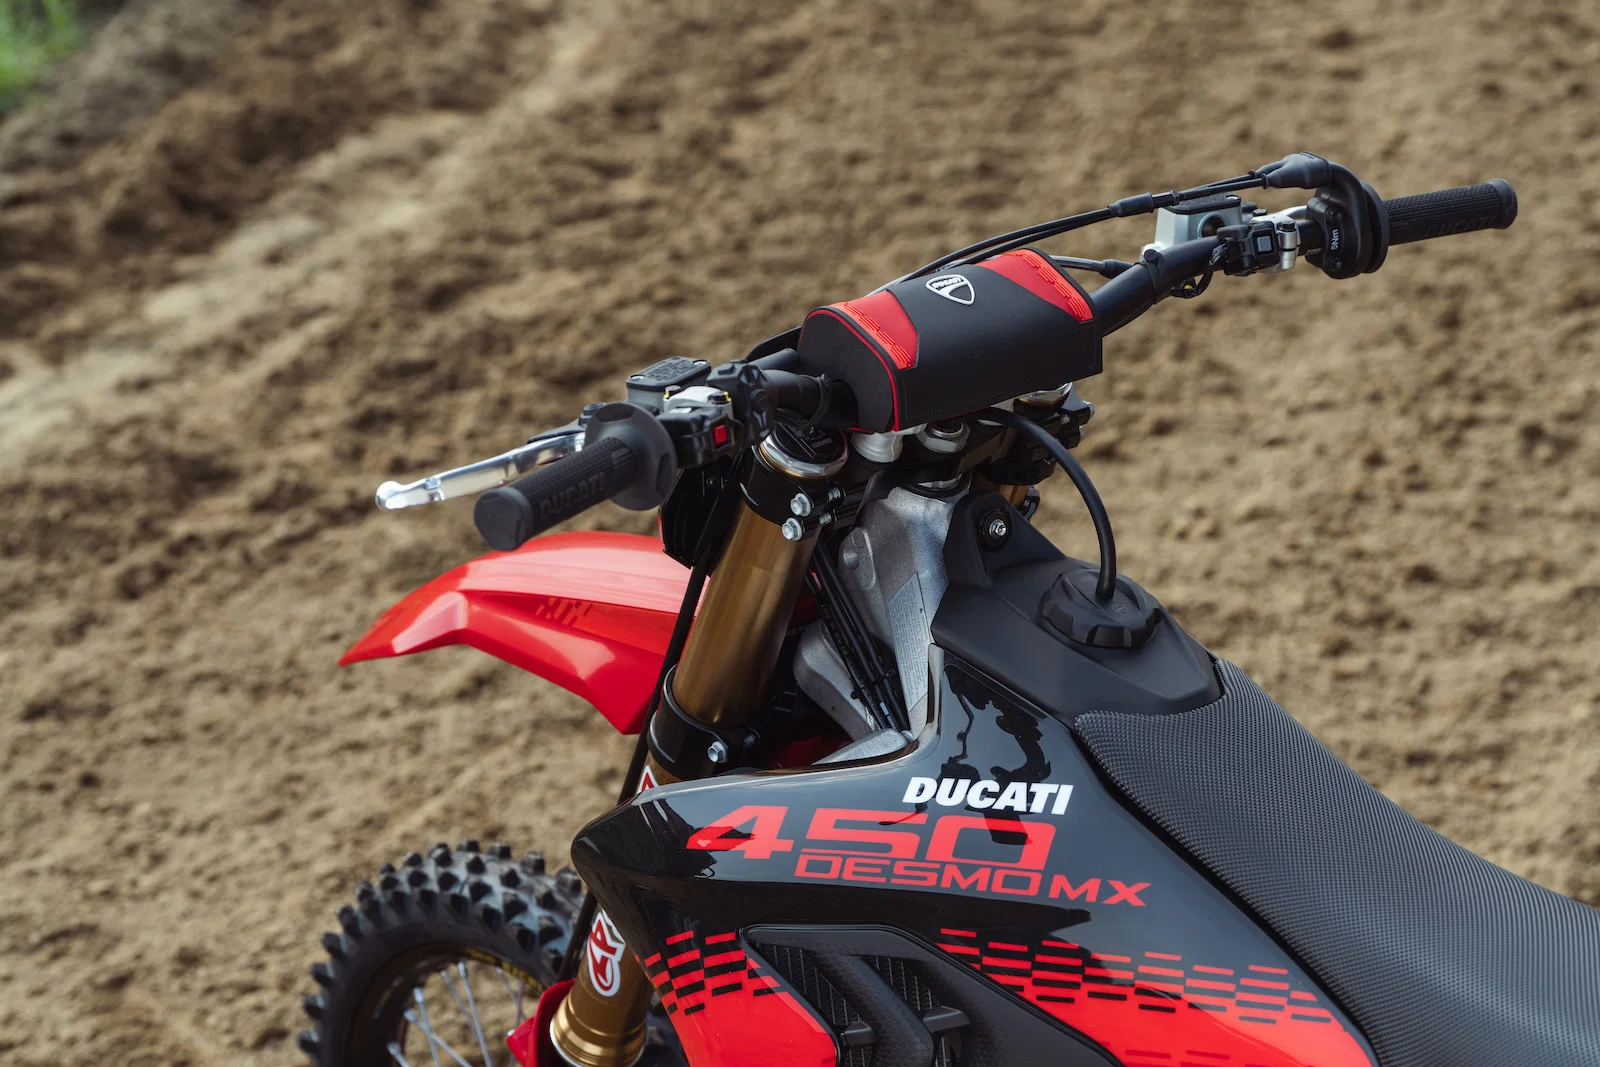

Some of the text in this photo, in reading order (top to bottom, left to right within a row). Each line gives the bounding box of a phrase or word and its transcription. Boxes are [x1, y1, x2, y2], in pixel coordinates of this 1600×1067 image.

[1331, 229, 1340, 250] 5Nm
[1424, 216, 1498, 239] DUCATI
[538, 472, 606, 517] DUCATI
[903, 777, 1074, 815] DUCATI
[686, 805, 1057, 870] 450
[794, 854, 1153, 907] DESMO MX
